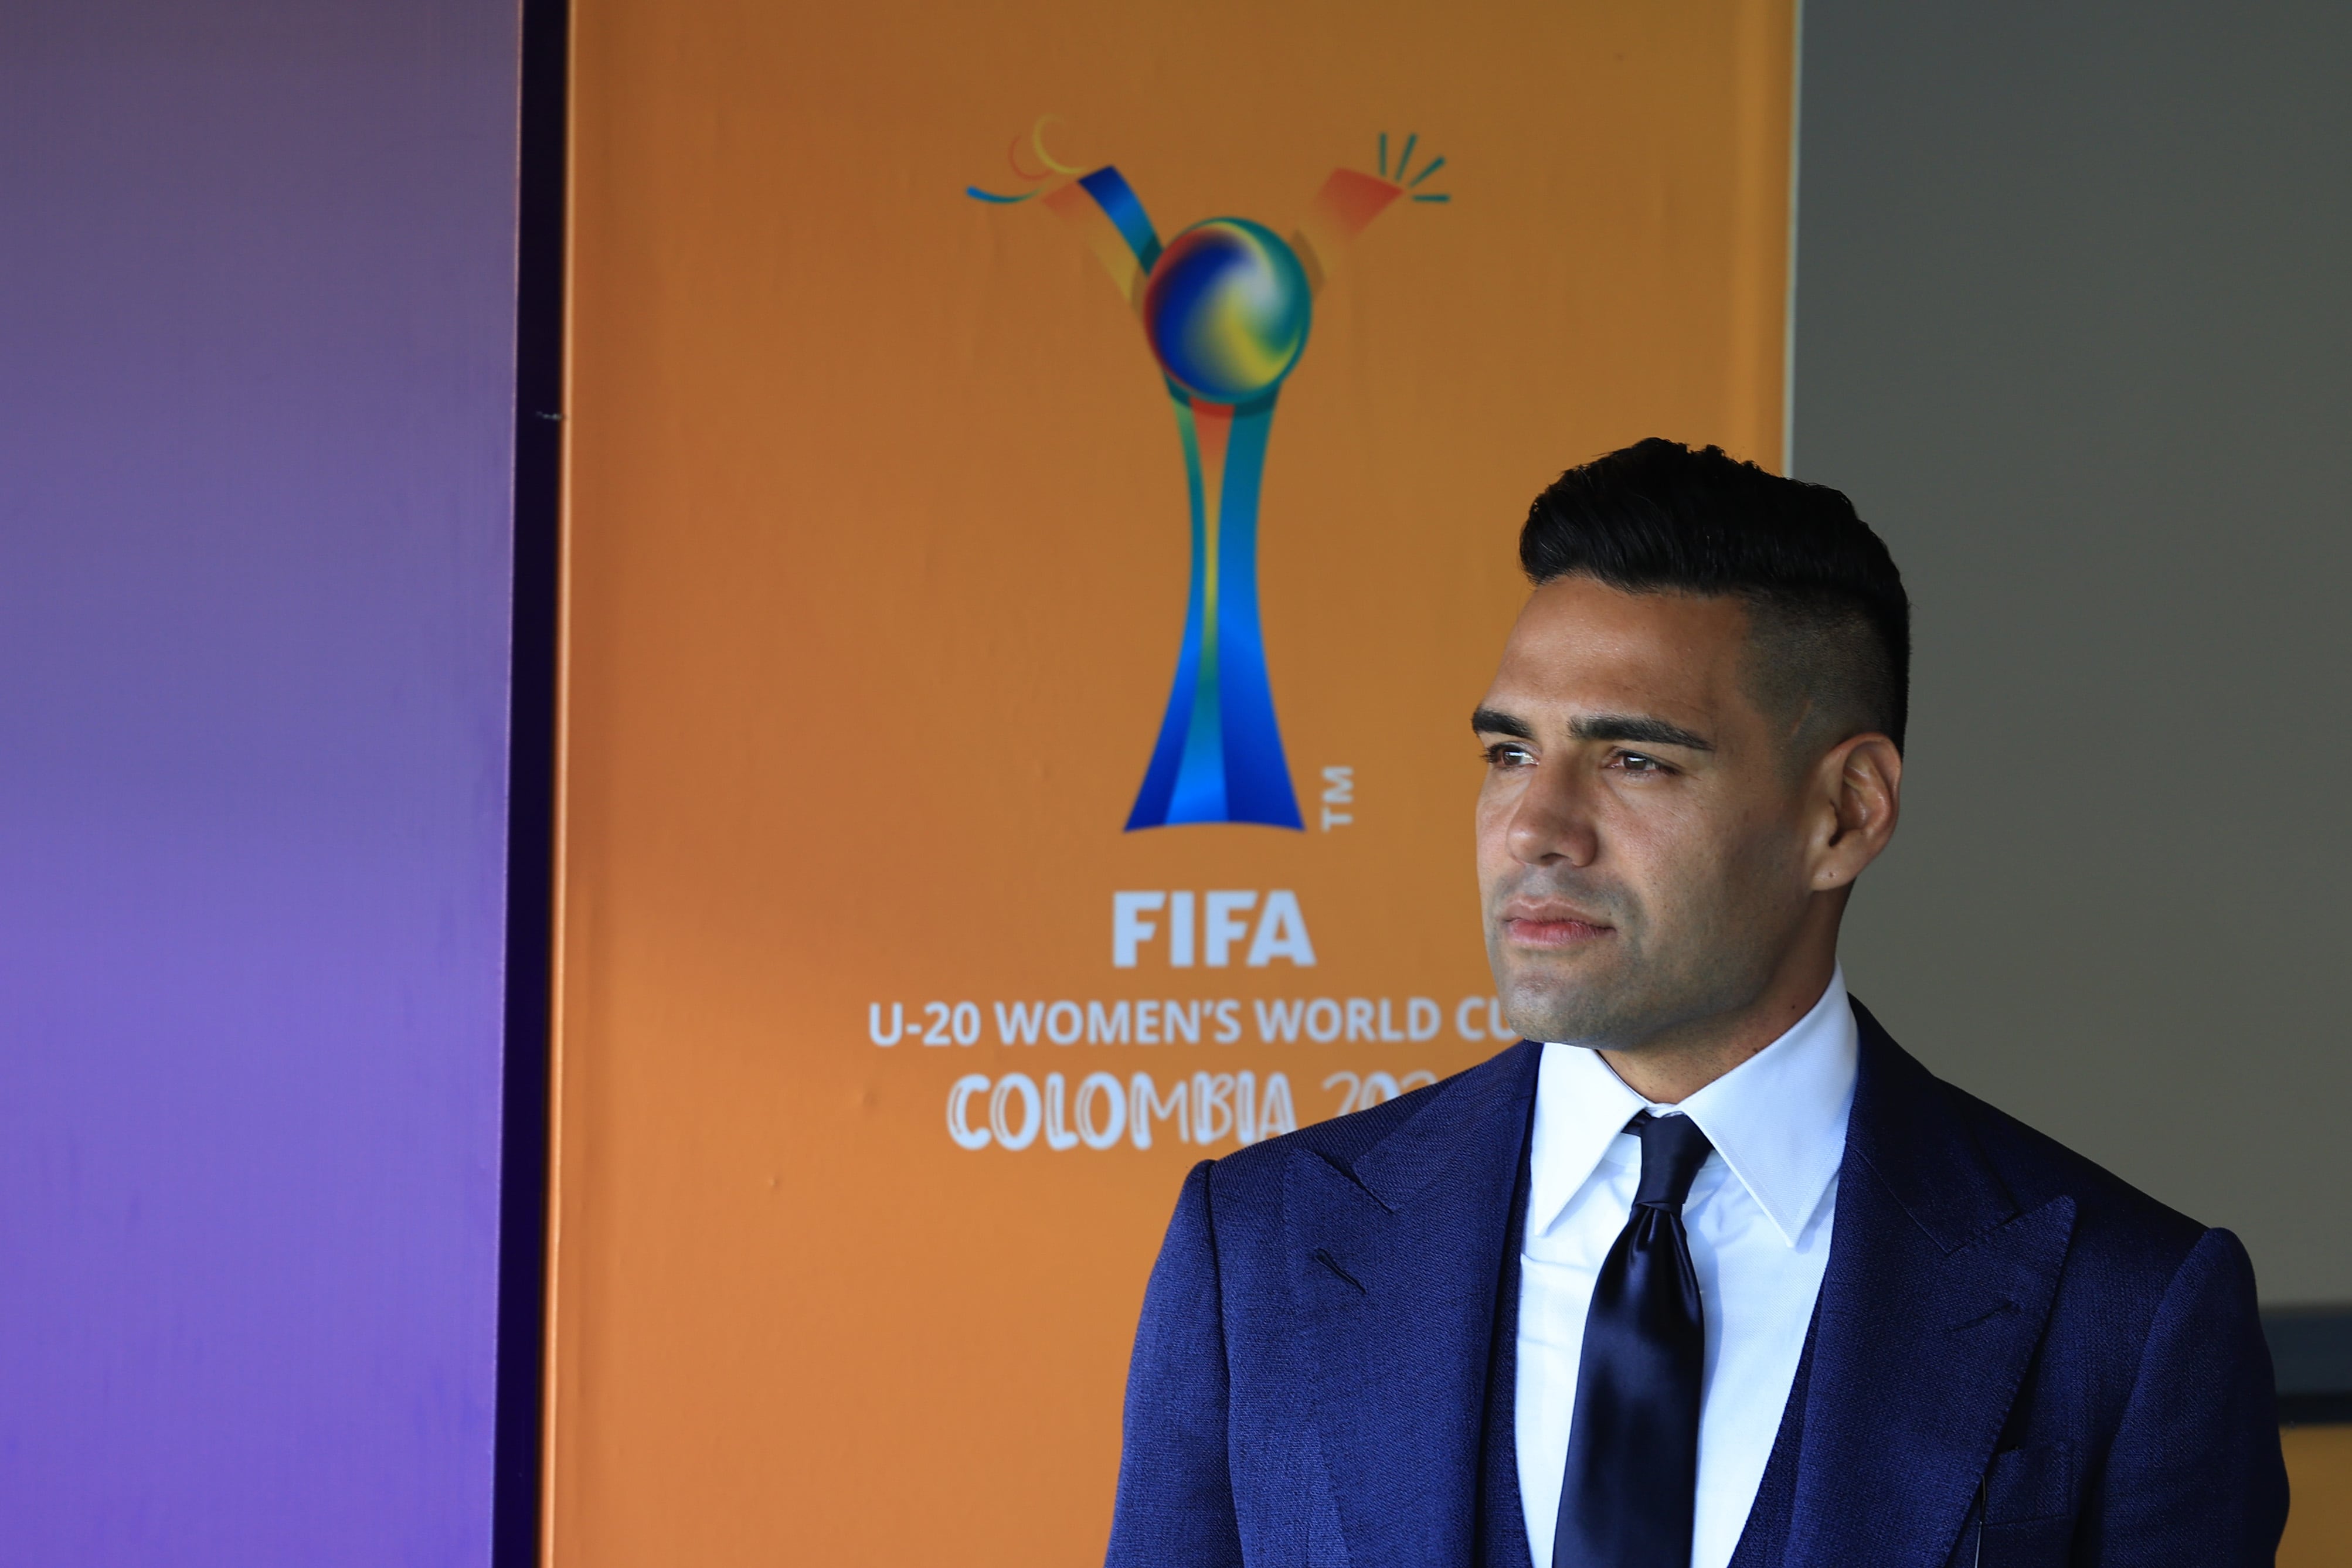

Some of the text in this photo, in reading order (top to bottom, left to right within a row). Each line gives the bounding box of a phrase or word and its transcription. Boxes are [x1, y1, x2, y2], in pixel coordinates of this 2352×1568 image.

[1322, 766, 1352, 830] TM
[1113, 890, 1317, 968] FIFA
[869, 995, 1518, 1046] U-20 WOMEN'S WORLD CU
[946, 1070, 1299, 1151] COLOMBIA
